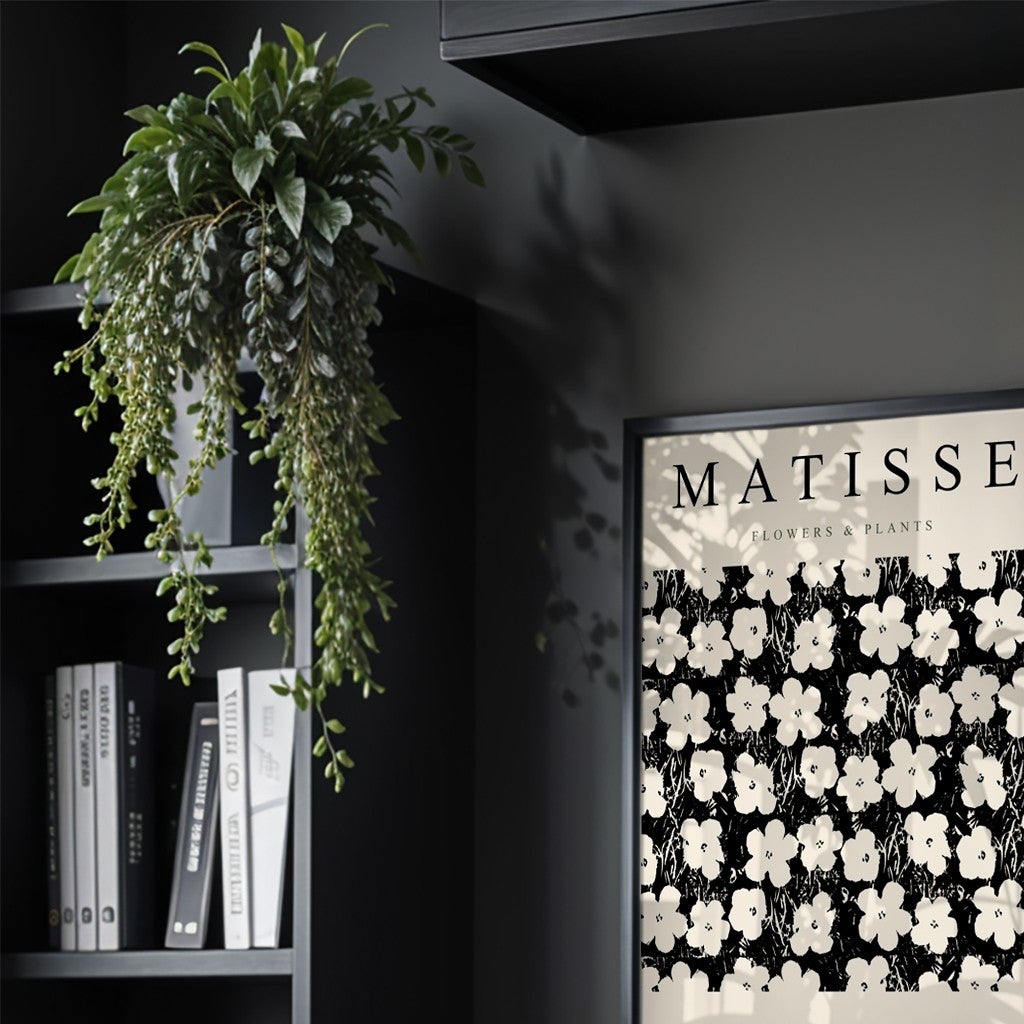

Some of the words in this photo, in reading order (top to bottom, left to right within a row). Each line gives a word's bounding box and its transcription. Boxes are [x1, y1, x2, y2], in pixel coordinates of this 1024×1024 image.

[672, 440, 1018, 508] MATISSE
[751, 525, 833, 542] FLOWERS
[843, 525, 854, 536] &
[864, 520, 934, 535] PLANTS
